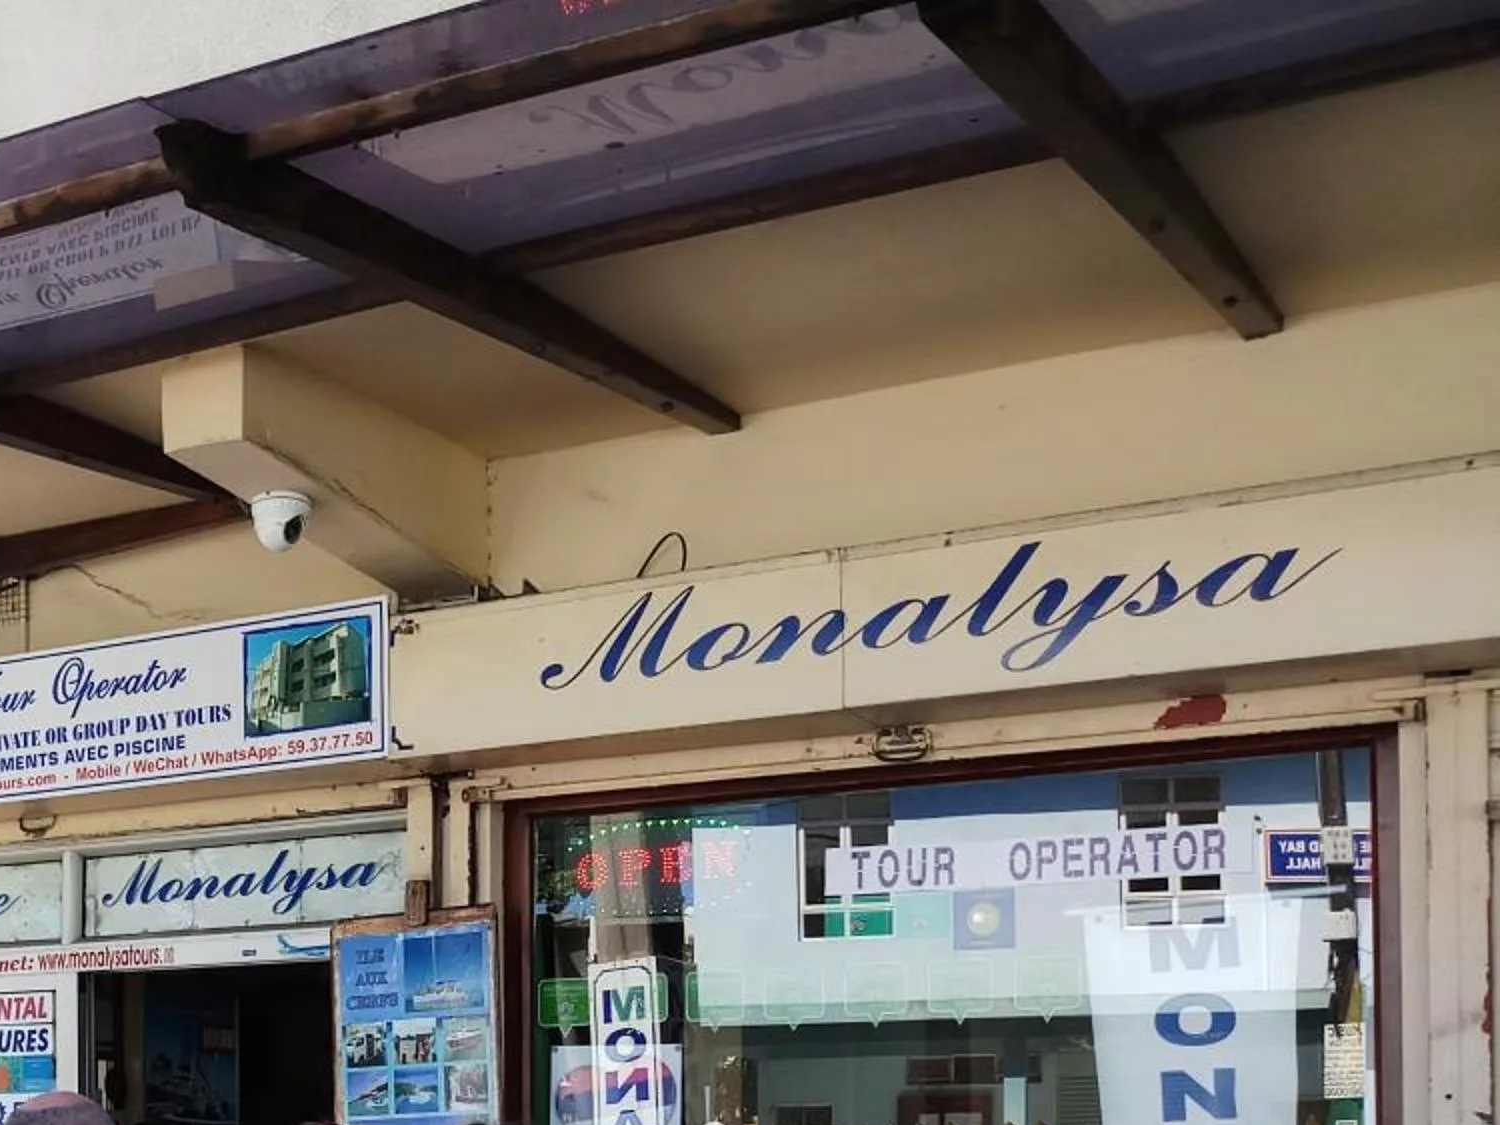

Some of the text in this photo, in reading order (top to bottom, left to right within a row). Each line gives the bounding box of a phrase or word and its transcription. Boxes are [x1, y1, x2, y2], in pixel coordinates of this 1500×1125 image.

[539, 539, 1342, 692] Monalysa
[51, 656, 188, 719] Operator
[45, 724, 68, 745] OR
[71, 715, 131, 741] GROUP
[135, 710, 170, 733] DAY
[173, 703, 232, 728] TOURS
[64, 742, 113, 764] AVEC
[115, 734, 187, 759] PISCINE
[76, 763, 122, 781] Mobile
[133, 754, 189, 774] WeChat
[200, 742, 283, 767] WhatsApp:
[287, 731, 374, 756] 59.37.77.50
[101, 848, 382, 914] Monalysa
[574, 840, 739, 891] OPEN
[850, 828, 1227, 890] TOUR OPERATOR
